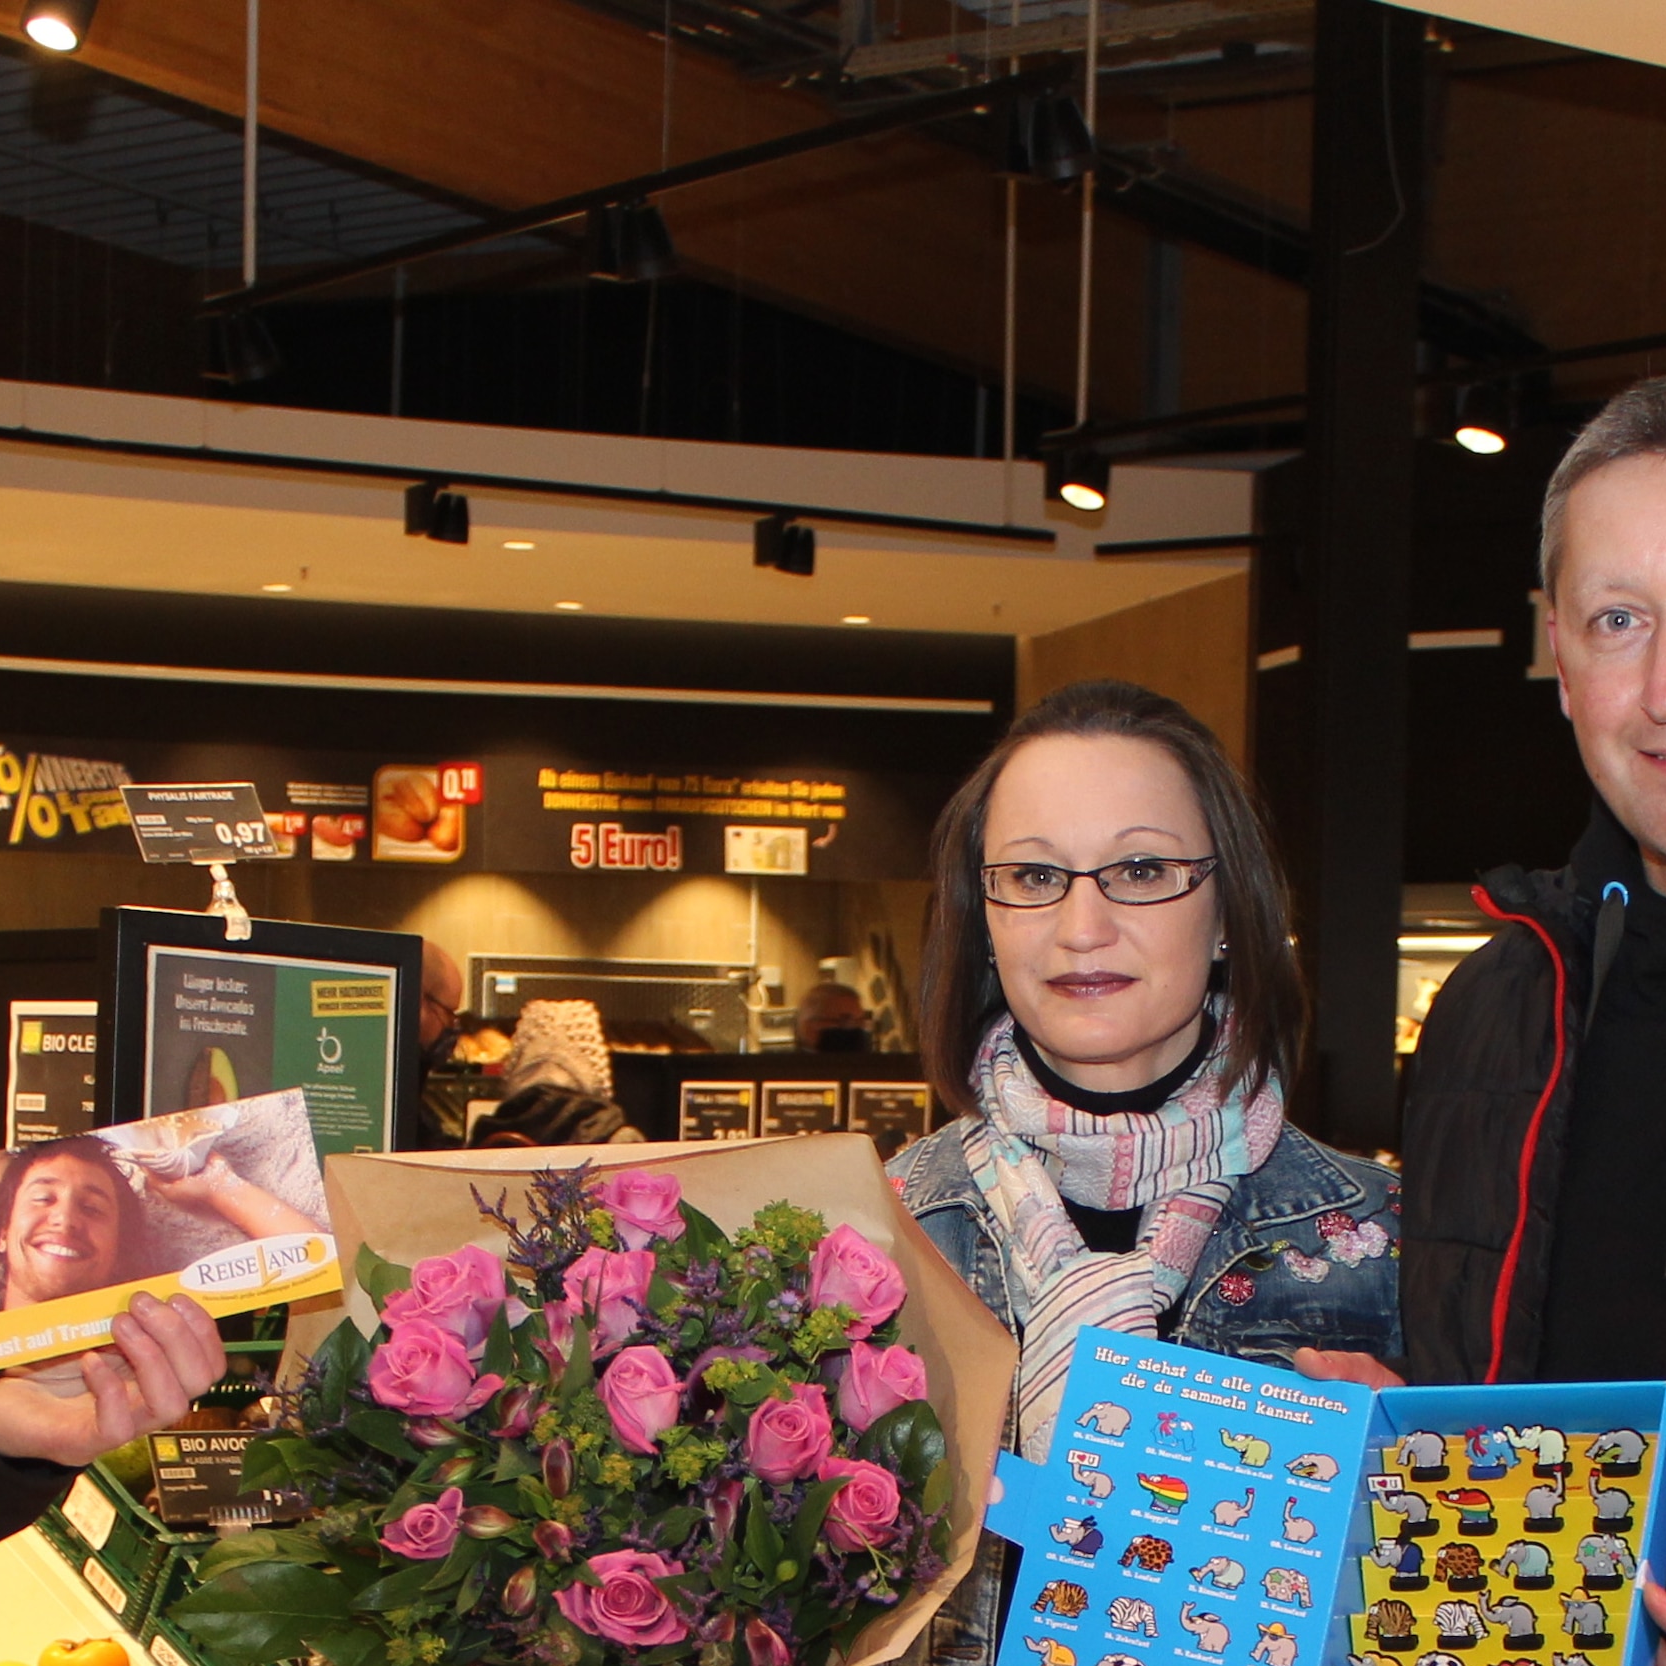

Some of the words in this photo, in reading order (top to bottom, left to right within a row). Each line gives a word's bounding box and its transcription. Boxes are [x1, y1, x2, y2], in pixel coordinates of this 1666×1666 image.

[148, 792, 188, 801] PHYSALIS
[189, 791, 235, 801] FAIRTRADE
[215, 822, 265, 848] 0,97
[571, 823, 597, 868] 5
[598, 822, 682, 871] Euro!
[42, 1033, 66, 1052] BIO
[23, 1327, 56, 1350] auf
[1094, 1347, 1130, 1367] Hier
[1137, 1357, 1188, 1379] siehst
[1195, 1370, 1214, 1385] du
[1221, 1375, 1252, 1394] alle
[1260, 1383, 1349, 1415] Ottifanten,
[1121, 1372, 1147, 1390] die
[1153, 1379, 1173, 1395] du
[1180, 1387, 1248, 1411] sammeln
[1254, 1400, 1315, 1425] kannst.
[180, 1437, 207, 1452] BIO
